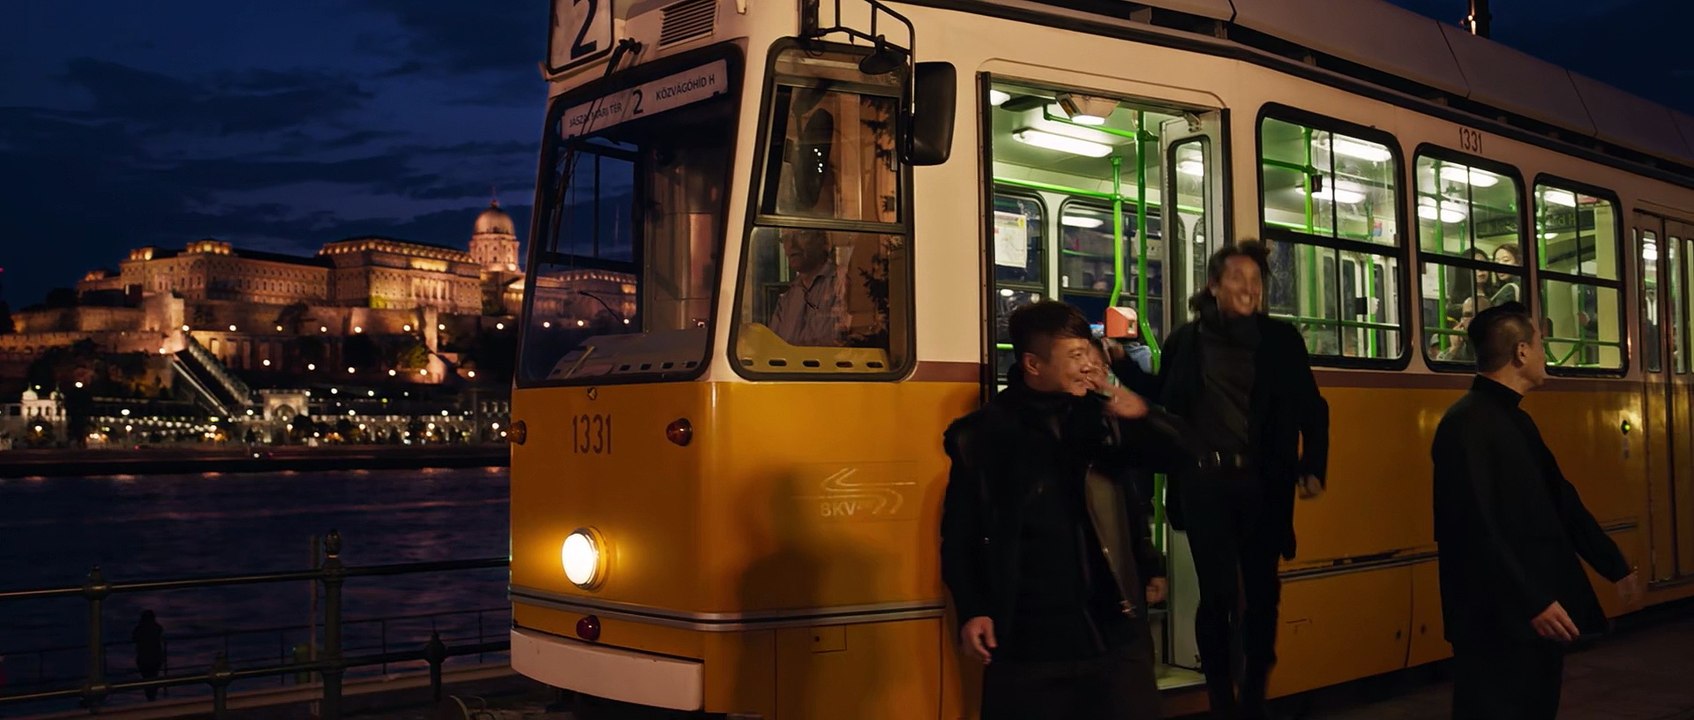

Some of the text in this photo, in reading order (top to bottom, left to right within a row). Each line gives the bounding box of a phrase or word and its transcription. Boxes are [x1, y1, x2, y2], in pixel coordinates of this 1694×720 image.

[570, 0, 598, 60] 2
[632, 89, 644, 115] 2
[709, 74, 715, 85] H
[1459, 127, 1482, 153] 1331
[573, 414, 611, 455] 1331
[820, 501, 856, 516] BKV
